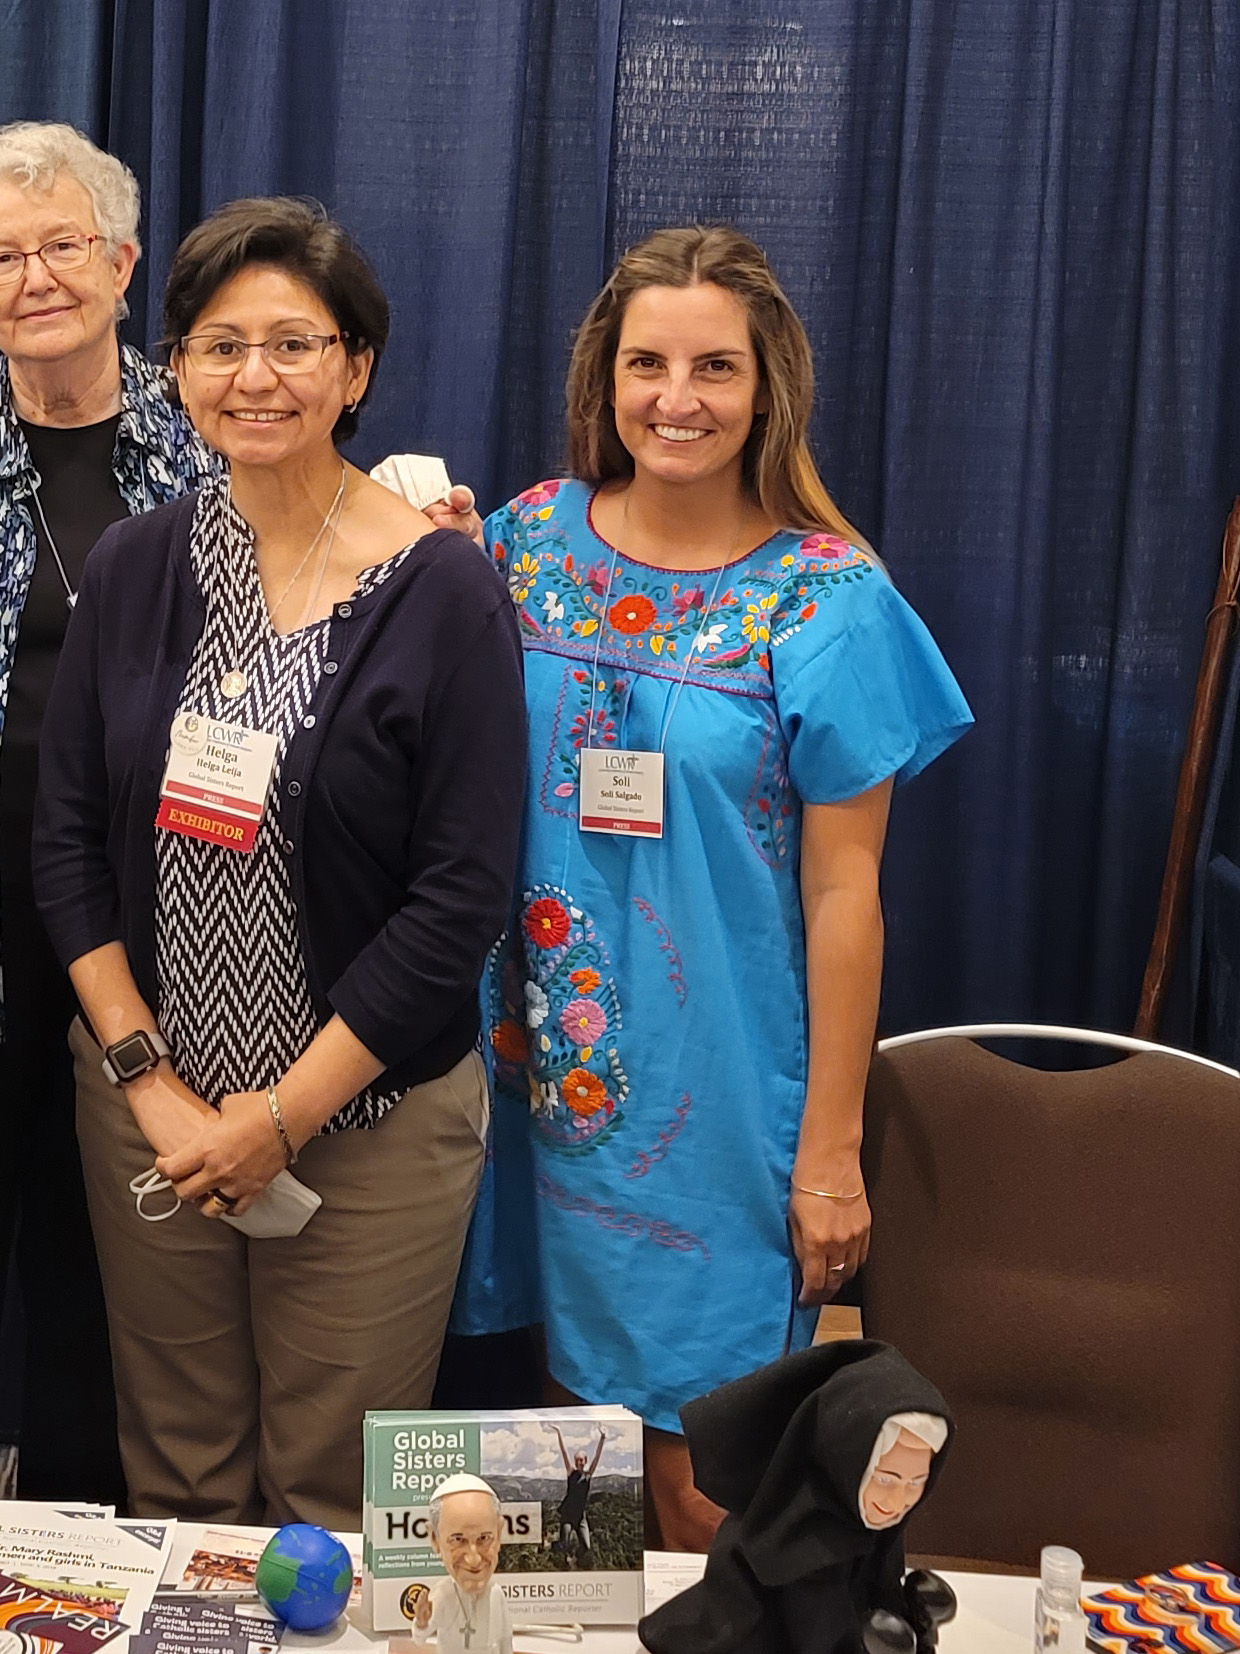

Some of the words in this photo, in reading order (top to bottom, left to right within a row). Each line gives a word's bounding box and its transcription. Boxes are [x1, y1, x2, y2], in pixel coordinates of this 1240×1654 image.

[207, 724, 243, 745] LCWR
[206, 745, 238, 763] Helga
[197, 758, 220, 772] Helga
[222, 765, 242, 778] Leija
[612, 776, 630, 787] Soli
[601, 790, 613, 798] Soli
[615, 790, 642, 801] Salgado
[168, 808, 244, 841] EXHIBITOR
[394, 1429, 464, 1450] Global
[393, 1451, 465, 1470] Sisters
[392, 1470, 464, 1493] Repo
[8, 1526, 64, 1539] SISTERS
[68, 1533, 122, 1546] REPORT
[12, 1545, 45, 1555] Mary
[28, 1555, 53, 1563] and
[55, 1557, 81, 1567] girls
[84, 1560, 96, 1568] in
[100, 1562, 155, 1575] Tanzania
[559, 1583, 613, 1597] REPORT
[151, 1603, 184, 1614] Giving
[533, 1603, 566, 1613] Catholic
[568, 1603, 603, 1614] Reporter
[155, 1616, 188, 1627] Giving
[189, 1620, 216, 1628] voice
[218, 1621, 230, 1629] to
[197, 1628, 230, 1636] sisters
[157, 1642, 191, 1654] Giving
